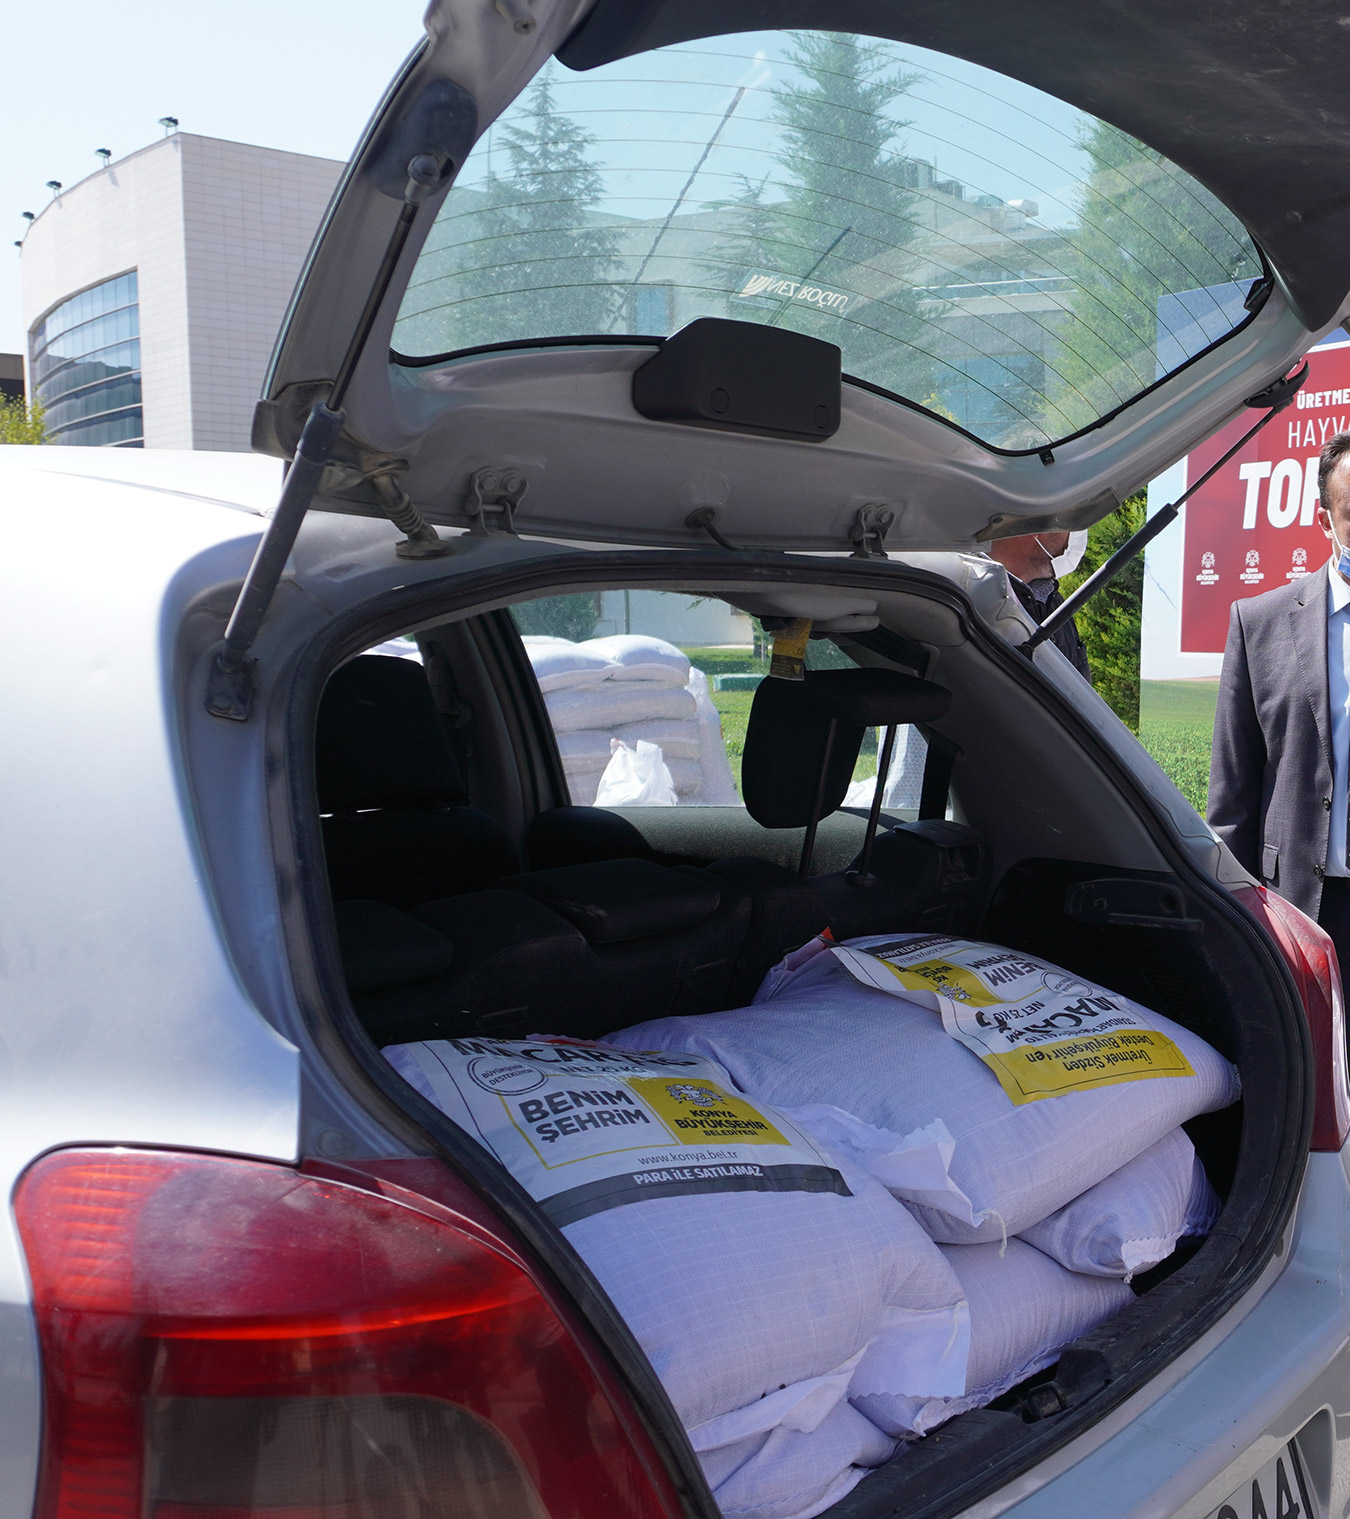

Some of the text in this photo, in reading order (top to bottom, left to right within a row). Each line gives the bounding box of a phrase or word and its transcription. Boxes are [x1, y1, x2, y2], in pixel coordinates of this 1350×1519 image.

[1009, 1009, 1020, 1019] 25
[1021, 1001, 1045, 1016] NET
[1120, 1034, 1154, 1046] Destek
[1062, 1048, 1152, 1072] Üretmek Sizden
[689, 1110, 738, 1119] KONYA
[674, 1118, 768, 1130] BÜYÜKŞEHİR
[637, 1151, 739, 1165] www.konya.bel.tr
[633, 1171, 672, 1185] PARA
[694, 1165, 764, 1180] SATILAMAZ
